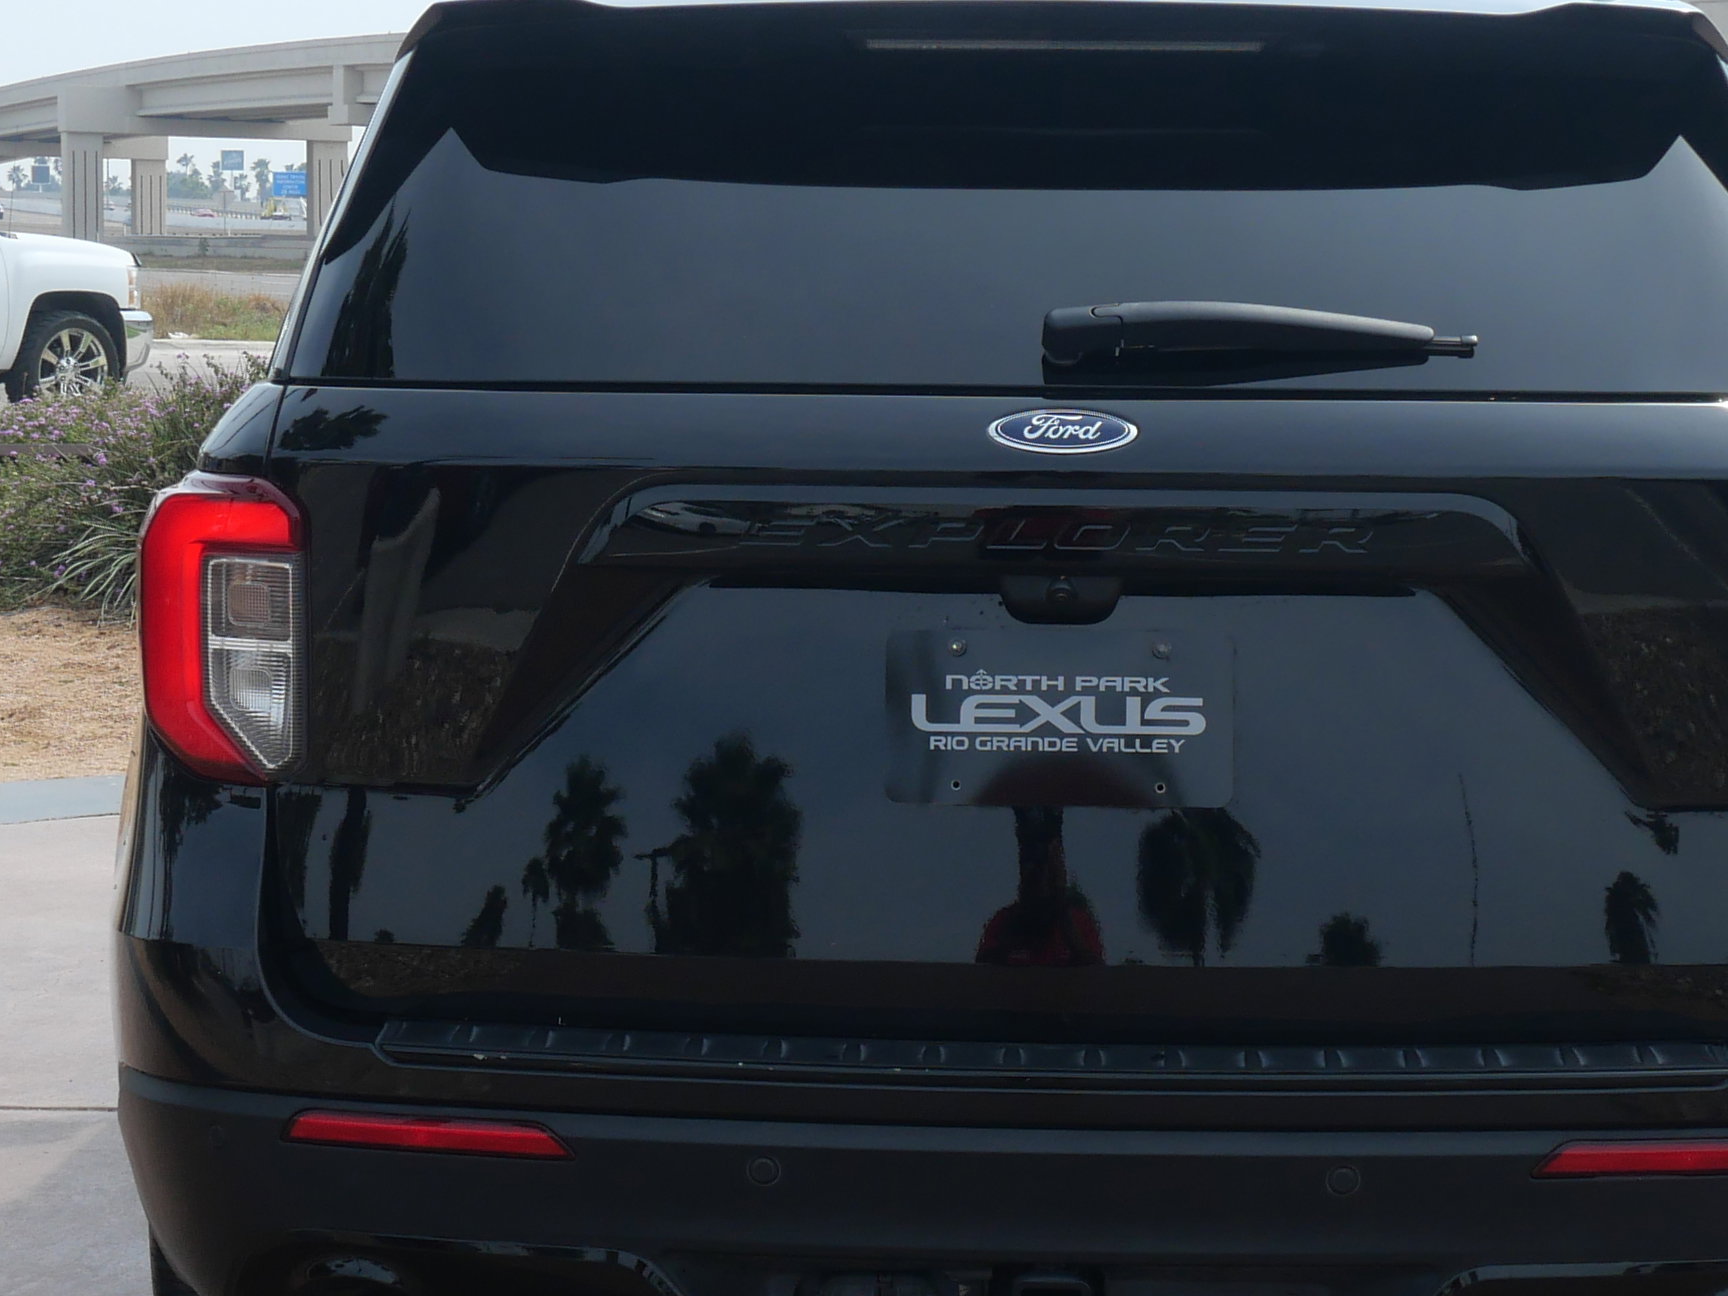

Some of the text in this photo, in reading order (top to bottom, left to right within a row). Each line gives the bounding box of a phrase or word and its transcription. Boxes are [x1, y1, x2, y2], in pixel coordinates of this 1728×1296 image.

[1023, 413, 1103, 440] Ford
[737, 514, 1374, 554] EXPLORER
[945, 670, 1171, 693] NORTH PARK
[911, 693, 1207, 736] LEXUS
[929, 735, 1186, 754] RIO GRANDE VALLEY
